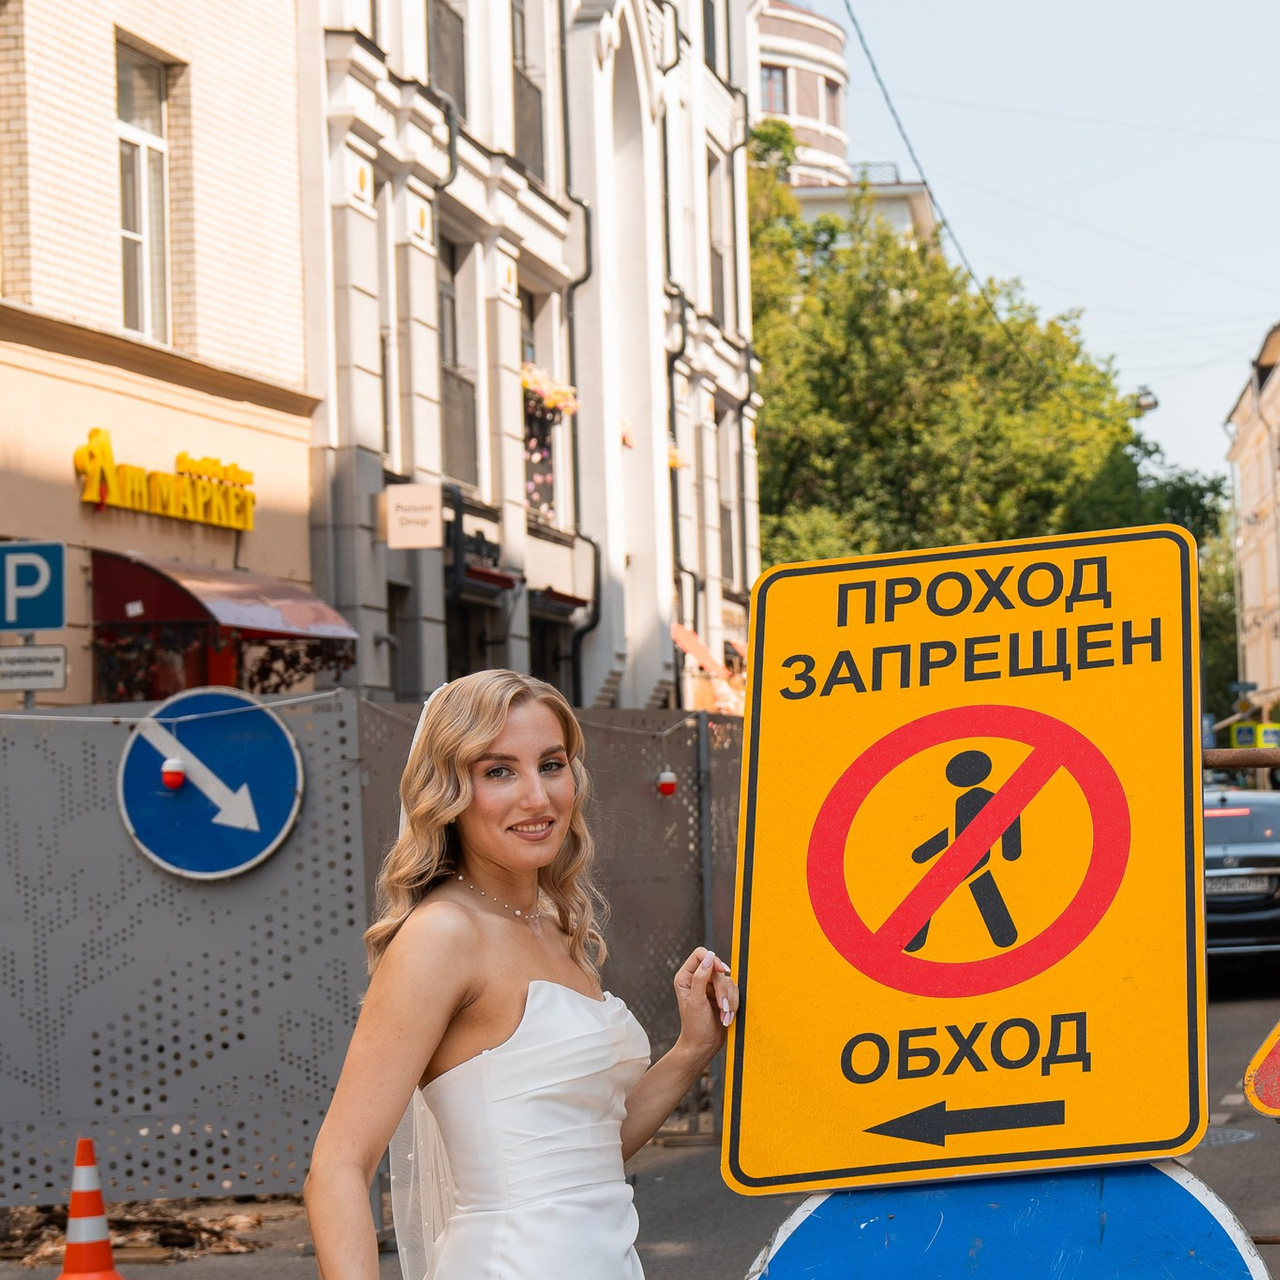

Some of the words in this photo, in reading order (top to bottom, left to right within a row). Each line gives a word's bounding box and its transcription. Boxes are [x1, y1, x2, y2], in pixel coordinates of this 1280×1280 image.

[5, 553, 51, 623] P
[838, 556, 1111, 627] ПРОХОД
[780, 618, 1162, 700] ЗАПРЕЩЕН
[841, 1012, 1091, 1084] ОБХОД
